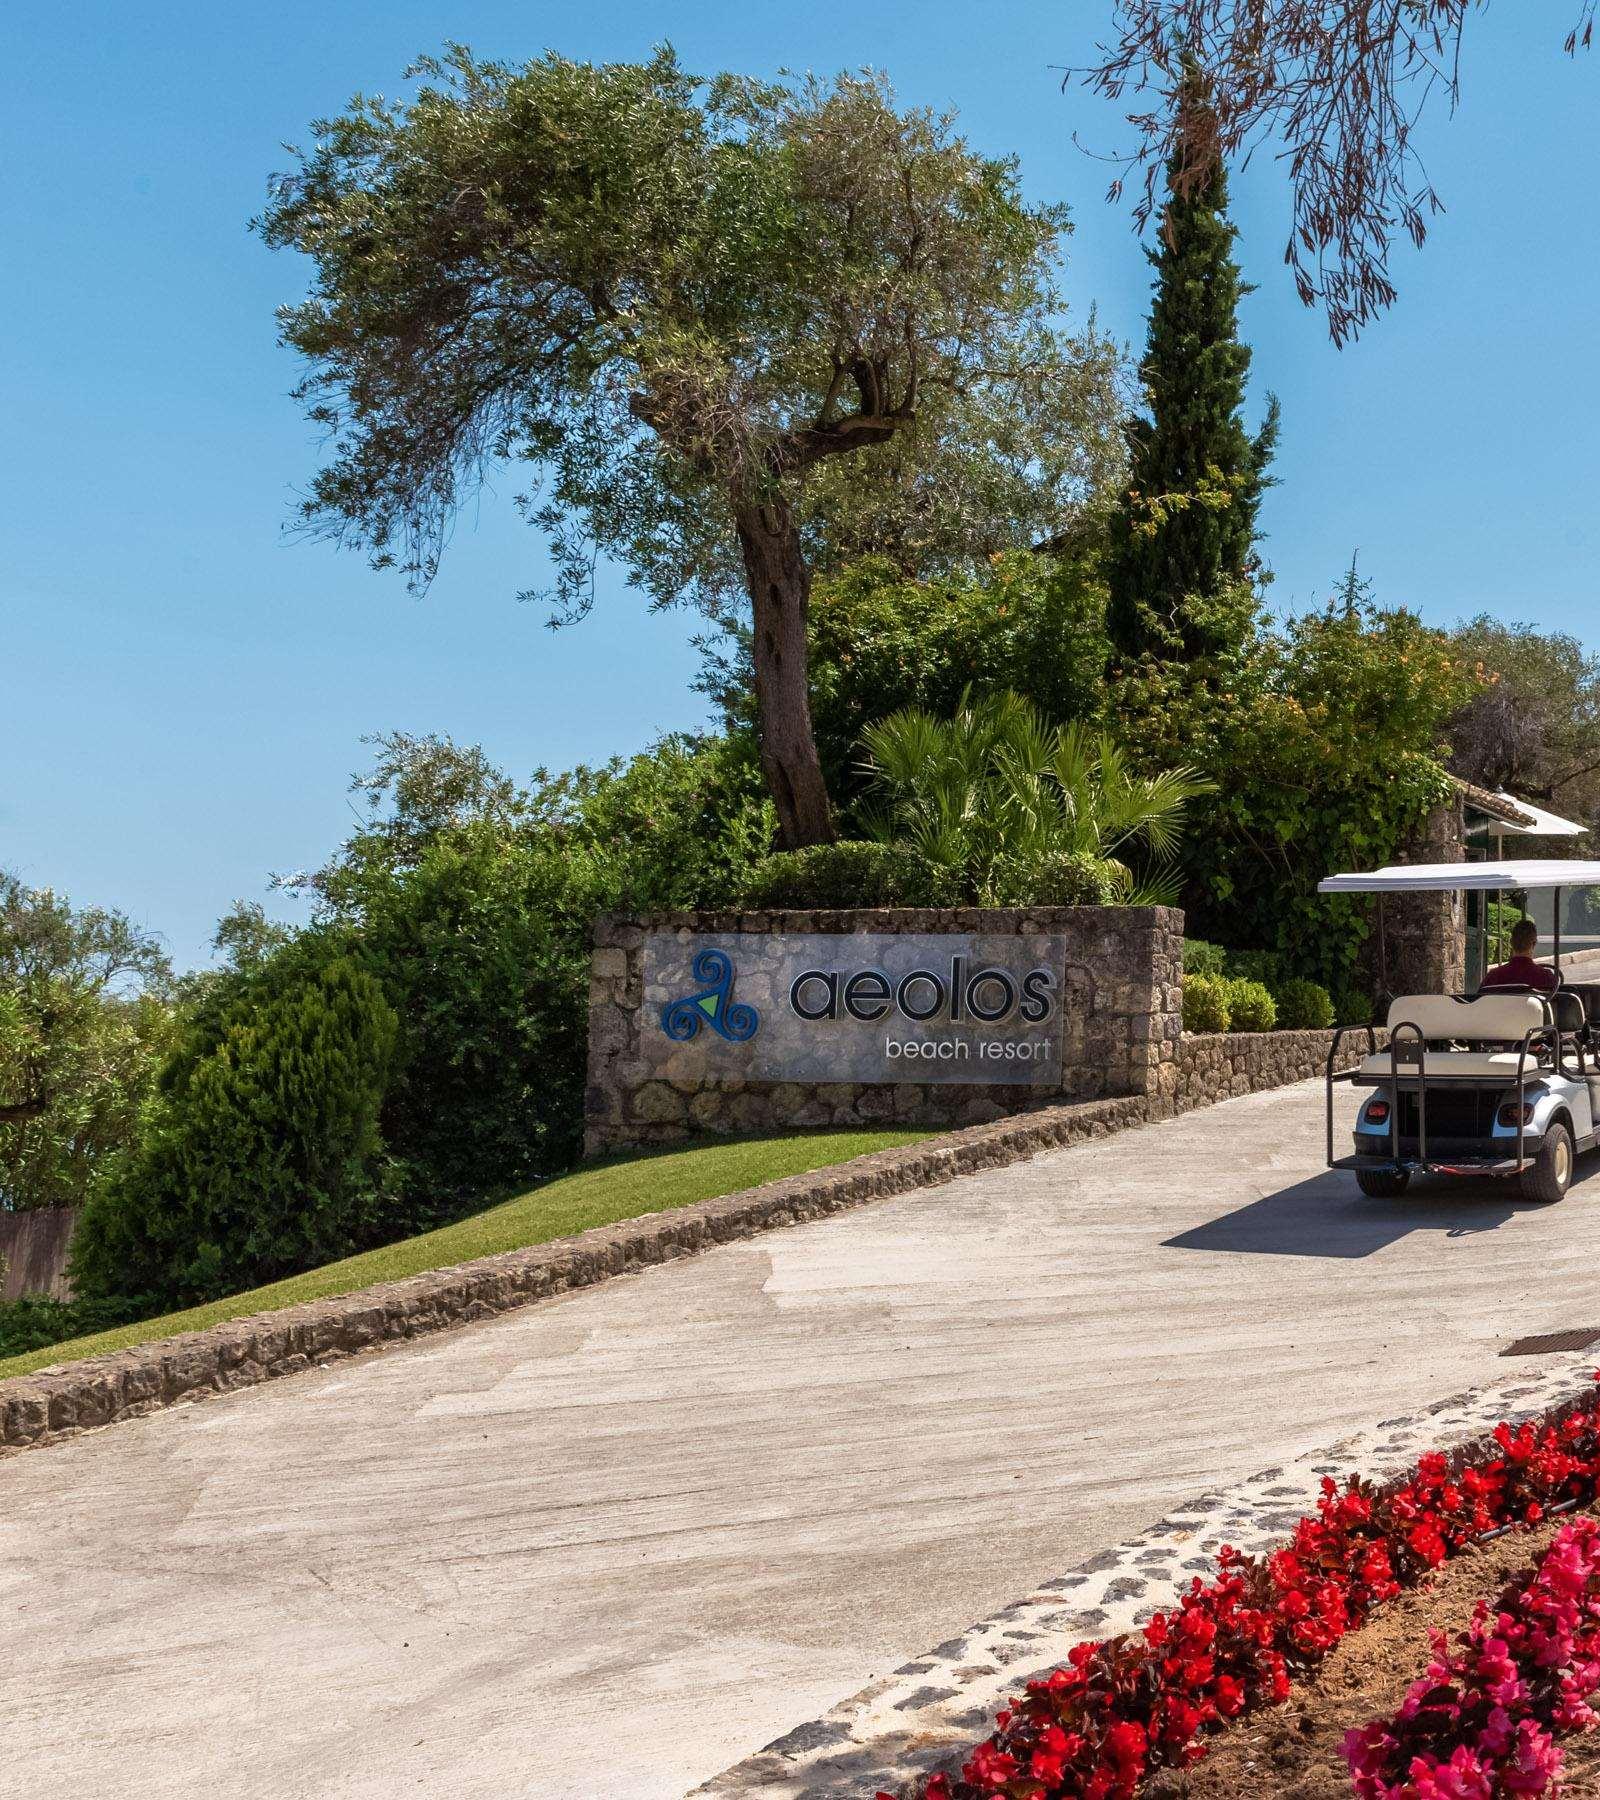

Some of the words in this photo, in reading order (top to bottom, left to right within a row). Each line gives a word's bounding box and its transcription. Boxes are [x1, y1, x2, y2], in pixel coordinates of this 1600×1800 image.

[789, 954, 1055, 1023] aeolos
[886, 1037, 969, 1060] beach
[979, 1038, 1051, 1060] resort
